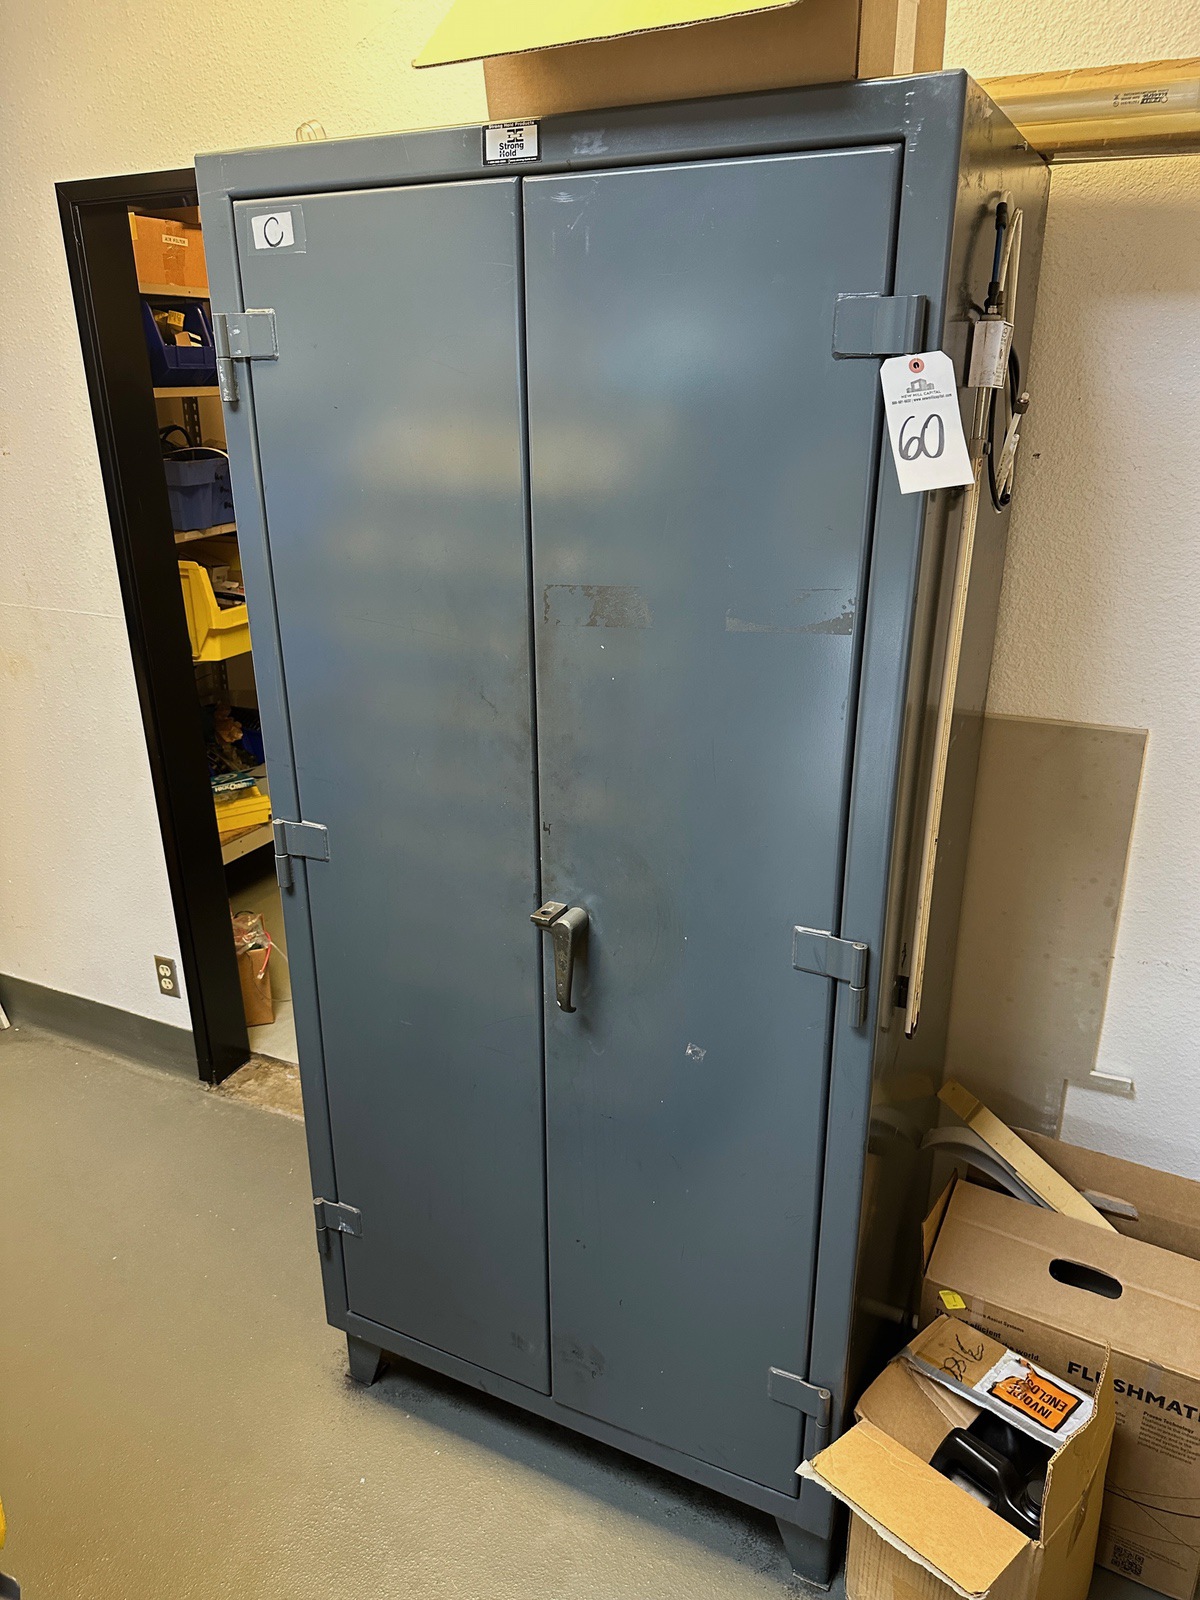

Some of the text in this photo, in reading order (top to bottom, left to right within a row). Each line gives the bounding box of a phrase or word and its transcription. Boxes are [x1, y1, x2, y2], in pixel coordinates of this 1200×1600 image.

[499, 142, 524, 151] Strong
[499, 150, 517, 158] Hold
[263, 216, 284, 248] C
[898, 413, 945, 461] 60
[1066, 1360, 1200, 1424] FLSHMAT
